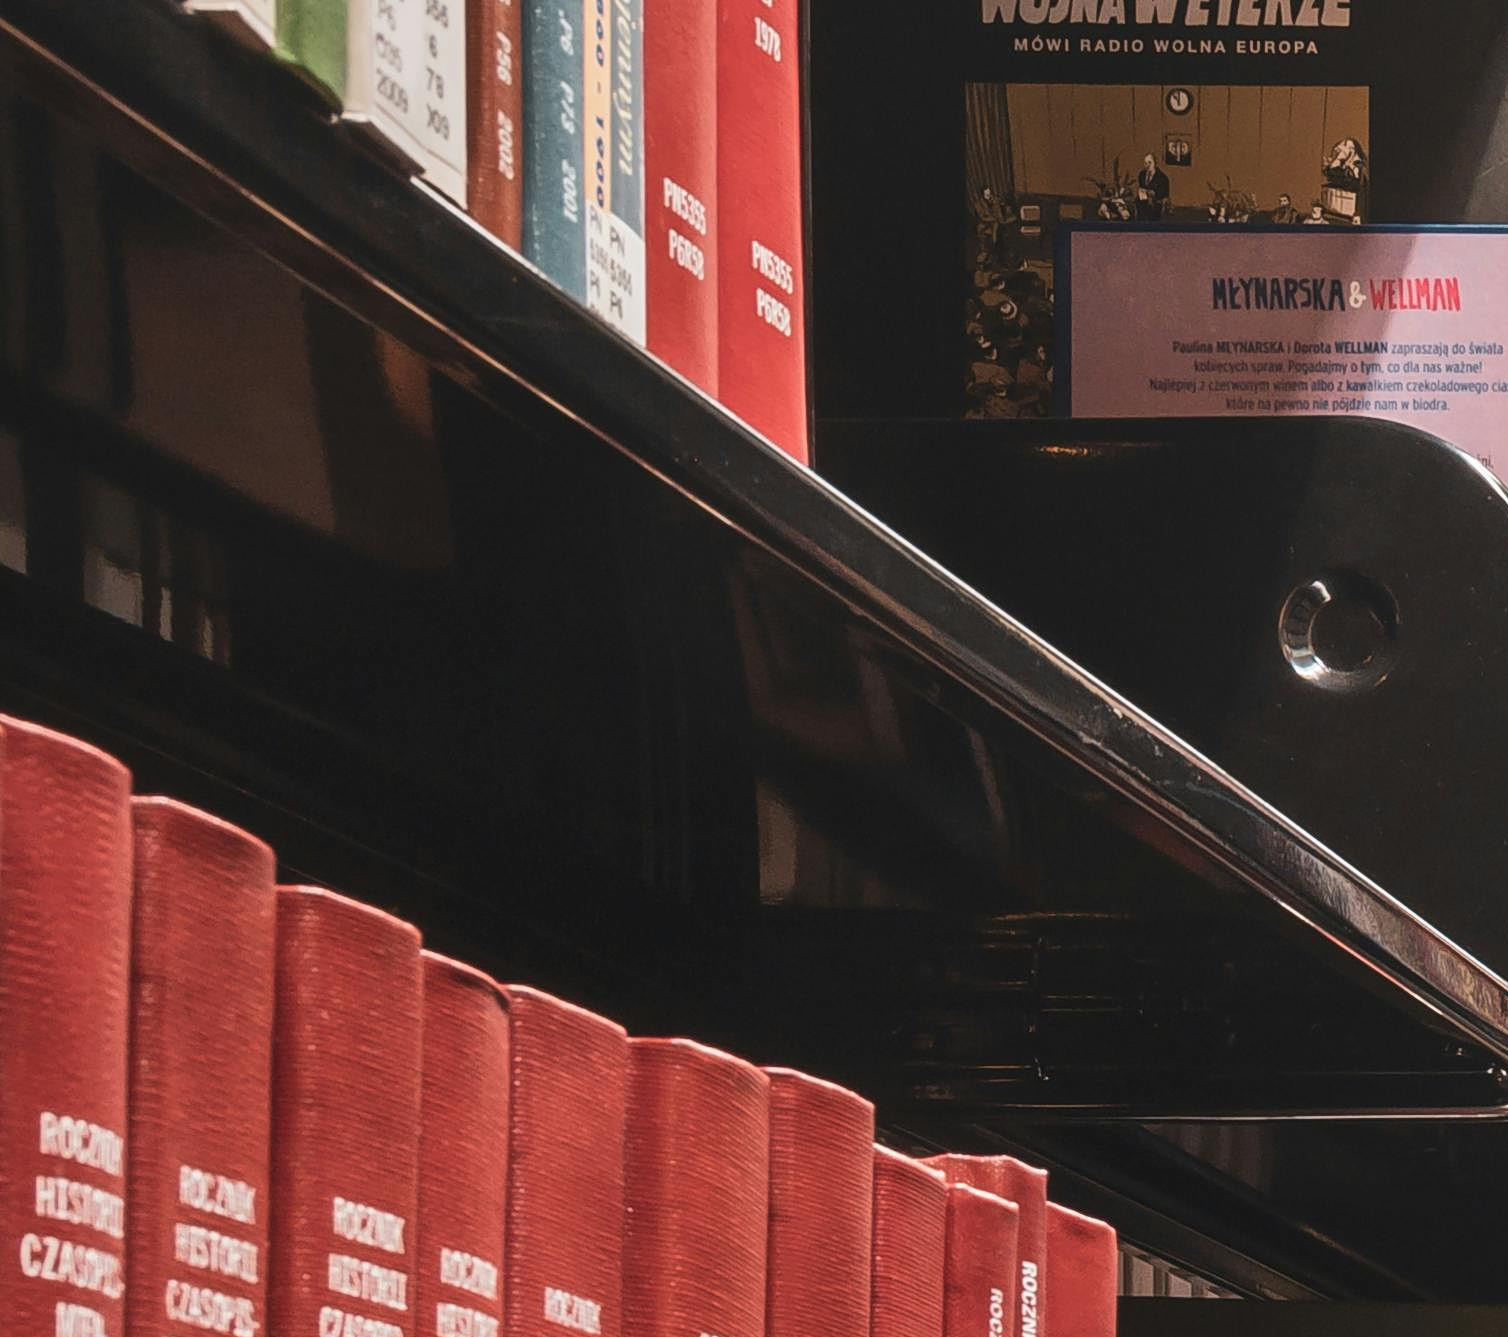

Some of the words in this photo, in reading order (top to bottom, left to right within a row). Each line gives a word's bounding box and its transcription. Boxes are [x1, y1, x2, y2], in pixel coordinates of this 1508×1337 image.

[755, 17, 781, 61] 1978
[1014, 36, 1071, 53] MÓWI
[1080, 39, 1145, 54] RADIO
[1154, 39, 1226, 54] WOLNA
[1236, 40, 1319, 55] EUROPA
[663, 177, 707, 236] PN5355
[1212, 277, 1346, 312] MŁYNARSKA
[1369, 277, 1462, 312] WELLMAN
[1335, 342, 1388, 355] WELLMAN
[1391, 342, 1449, 358] zapraszają
[1468, 340, 1504, 354] świata
[1406, 379, 1489, 395] czekoladowego
